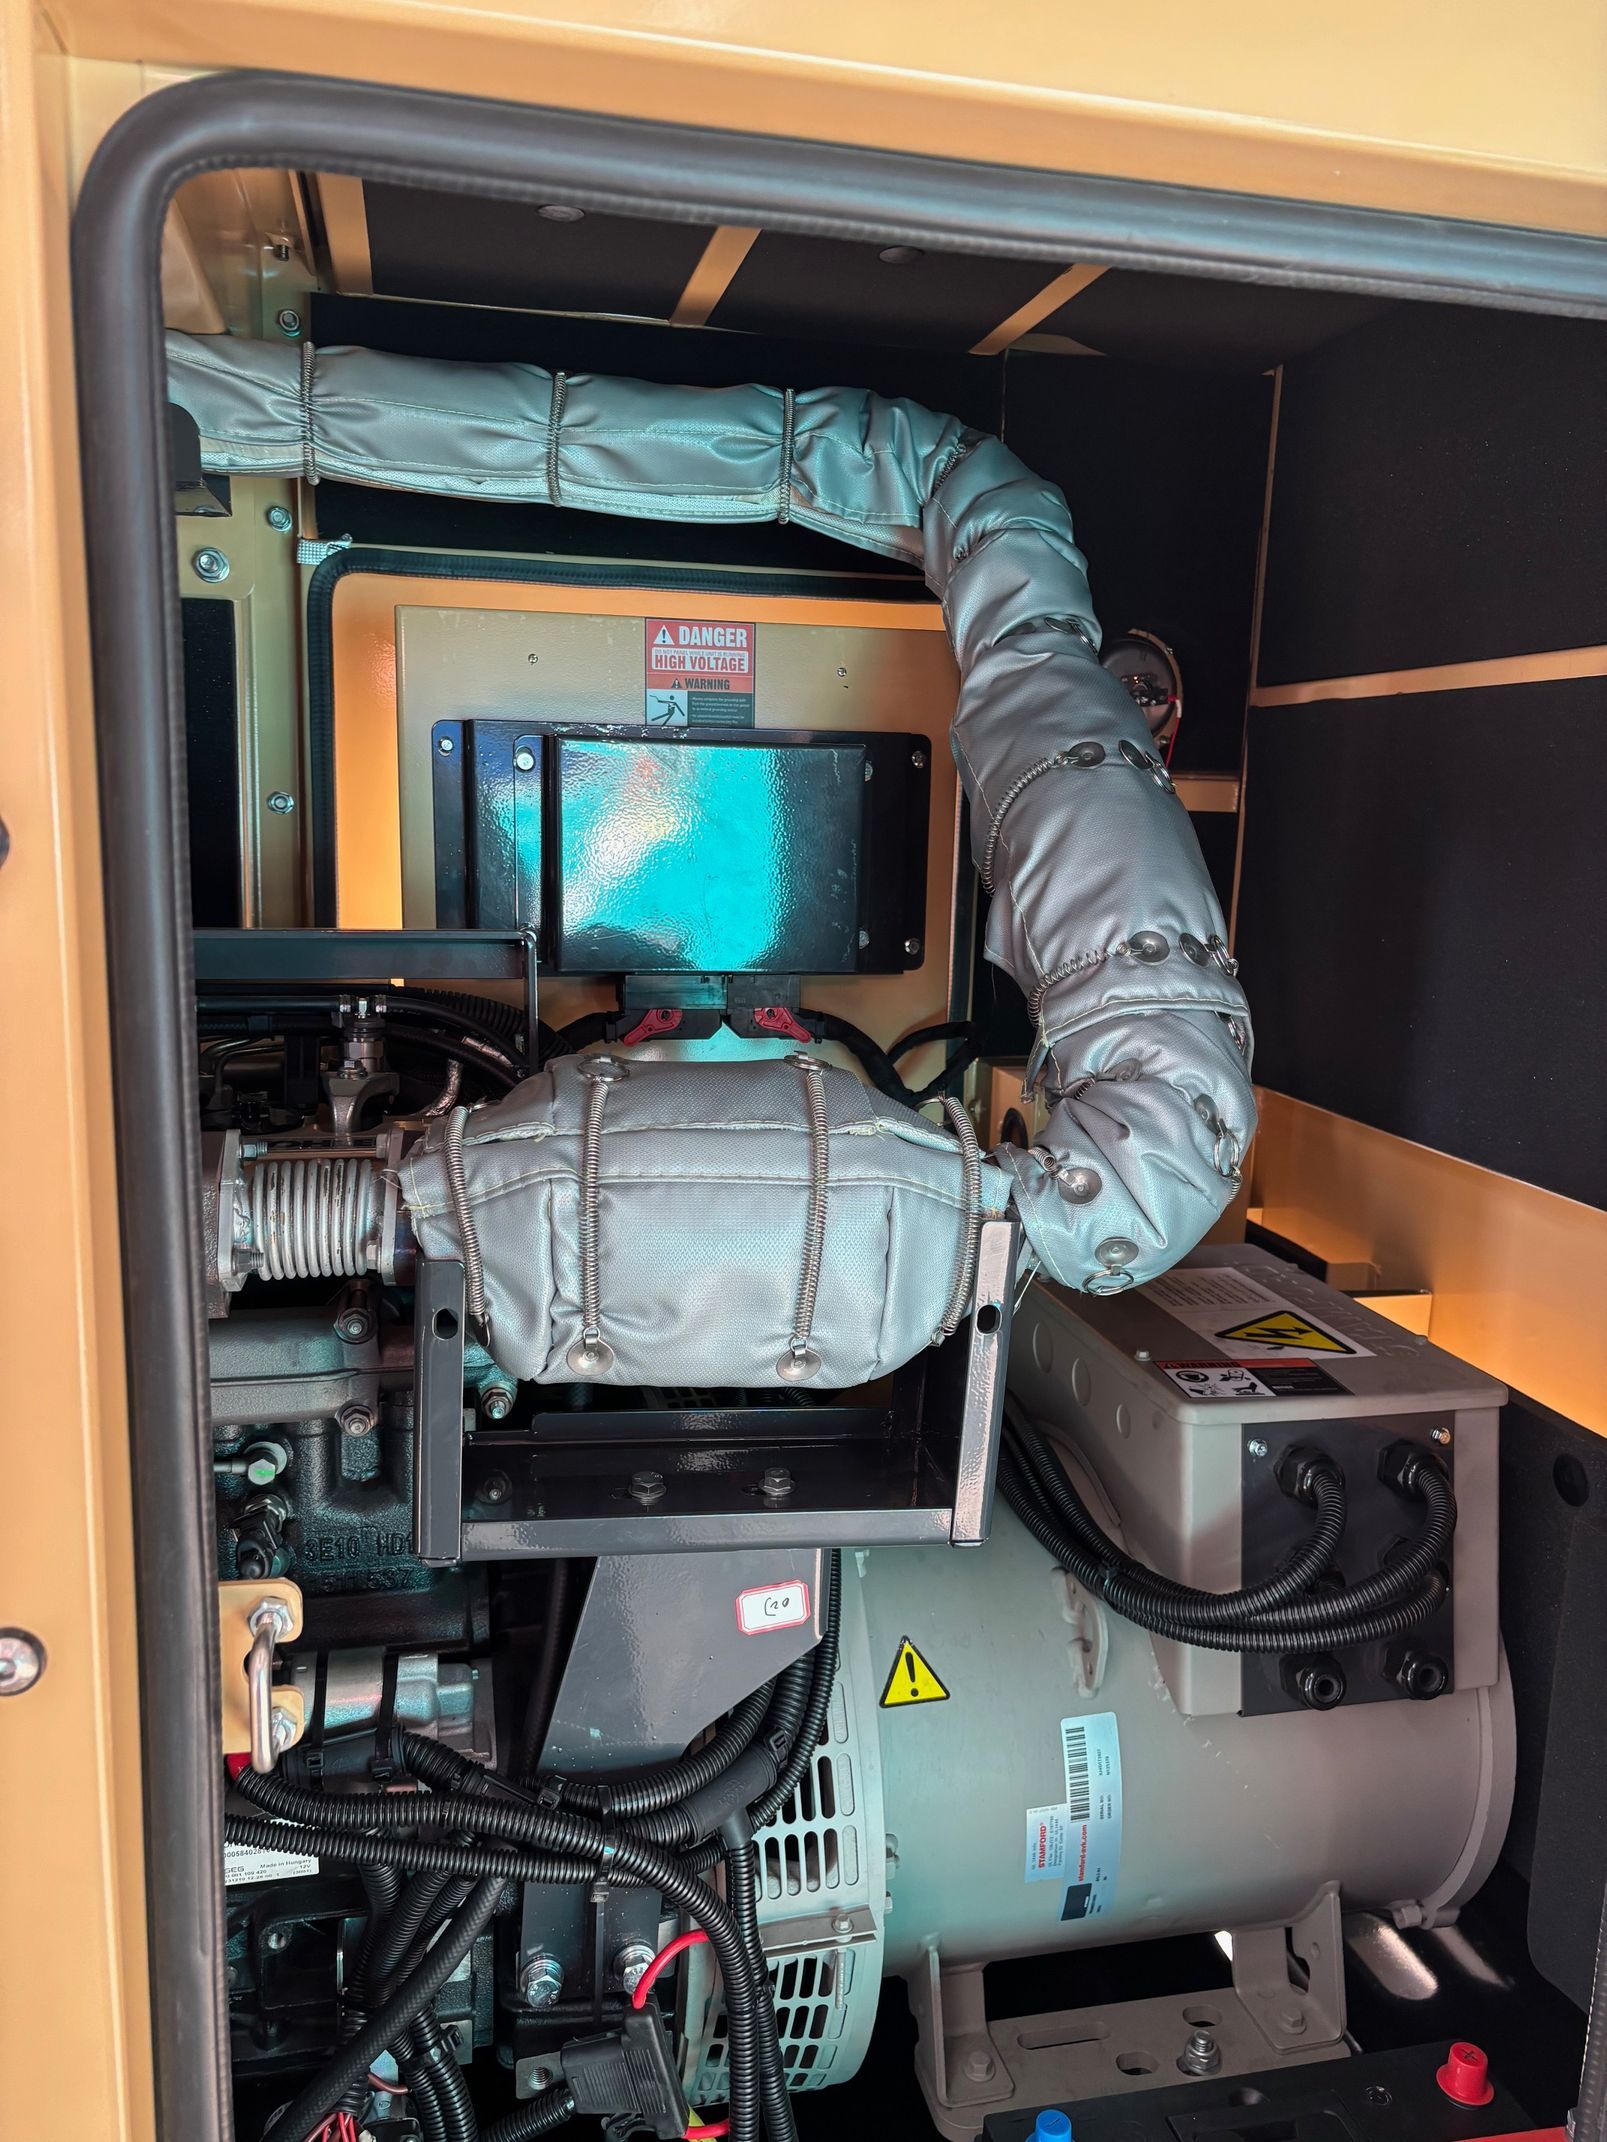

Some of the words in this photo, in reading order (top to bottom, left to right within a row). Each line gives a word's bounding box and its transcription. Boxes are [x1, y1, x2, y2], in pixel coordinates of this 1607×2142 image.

[678, 625, 748, 648] DANGER
[654, 654, 686, 669] HIGH
[689, 656, 745, 672] VOLTAGE
[684, 677, 730, 690] WARNING
[1078, 1824, 1088, 1882] stamford-avk.com
